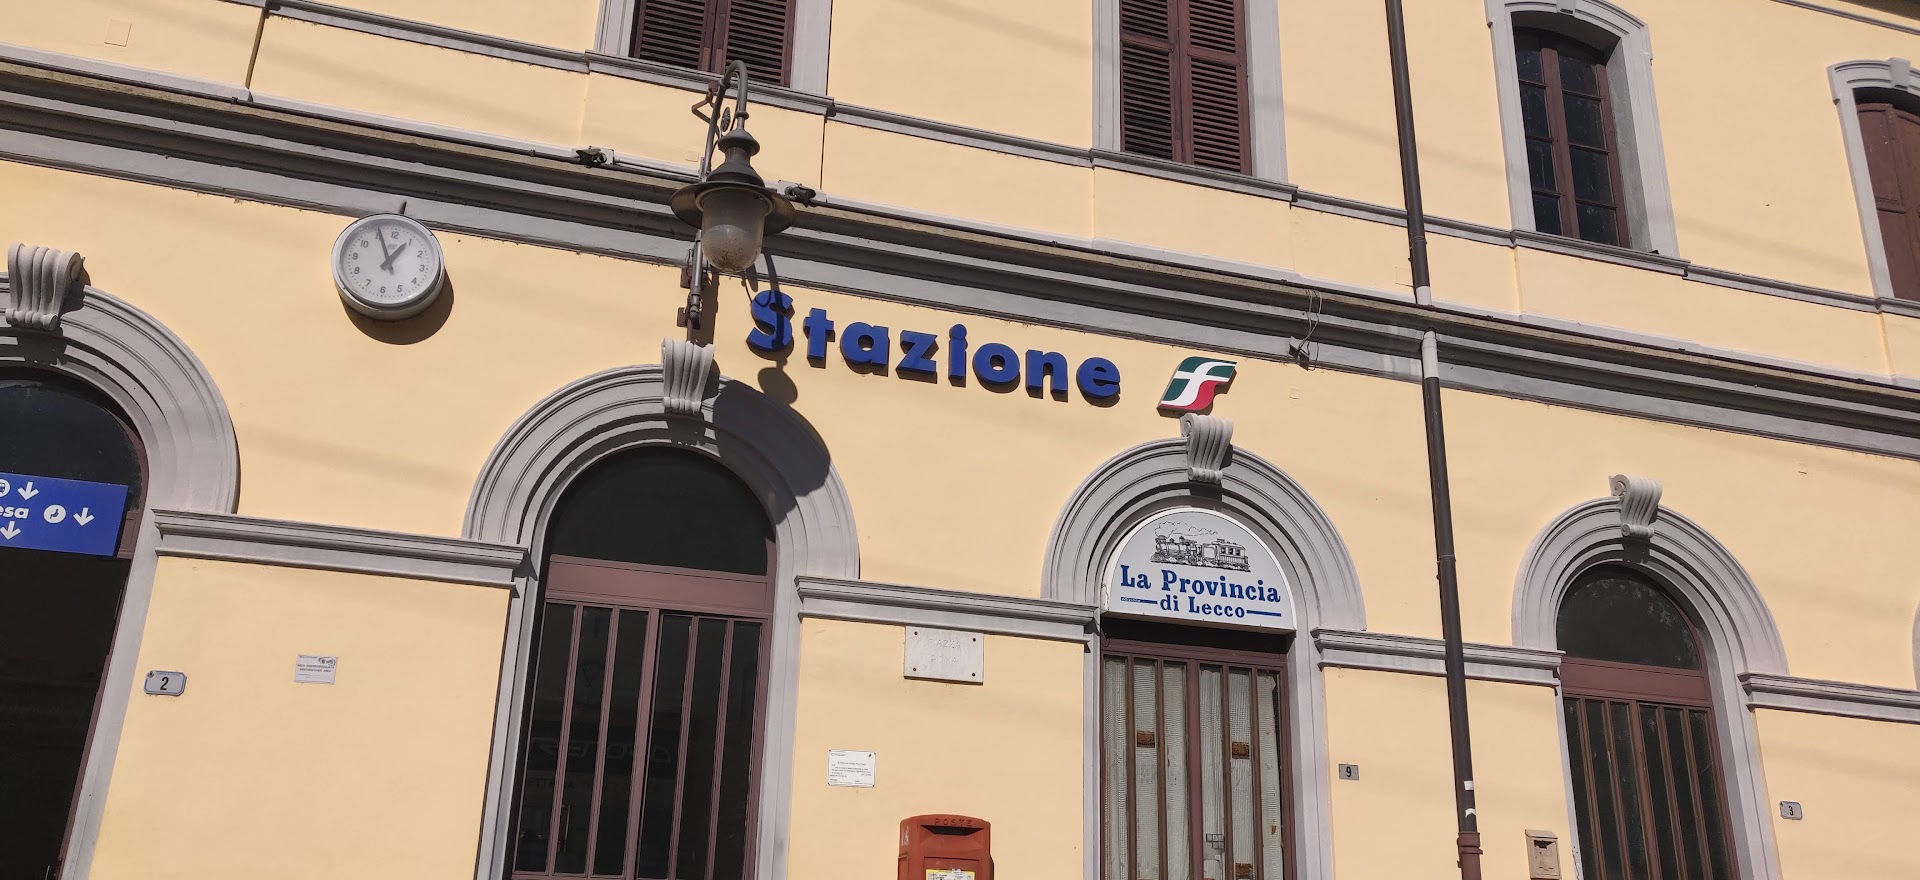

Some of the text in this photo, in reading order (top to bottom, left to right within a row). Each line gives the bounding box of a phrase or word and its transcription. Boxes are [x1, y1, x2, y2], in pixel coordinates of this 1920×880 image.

[391, 231, 399, 239] 12
[360, 240, 369, 248] 10
[408, 238, 412, 246] 1
[352, 252, 359, 260] 9
[417, 250, 423, 258] 2
[354, 266, 360, 275] 8
[419, 264, 425, 272] 3
[365, 279, 372, 287] 7
[411, 277, 417, 285] 4
[380, 286, 386, 294] 6
[746, 289, 1121, 403] Stazione
[1120, 564, 1281, 603] La Provincia
[1160, 594, 1245, 618] di Lecco
[160, 676, 169, 690] 2
[1346, 766, 1351, 777] 9
[1788, 805, 1793, 816] 3
[934, 818, 973, 827] POSTE
